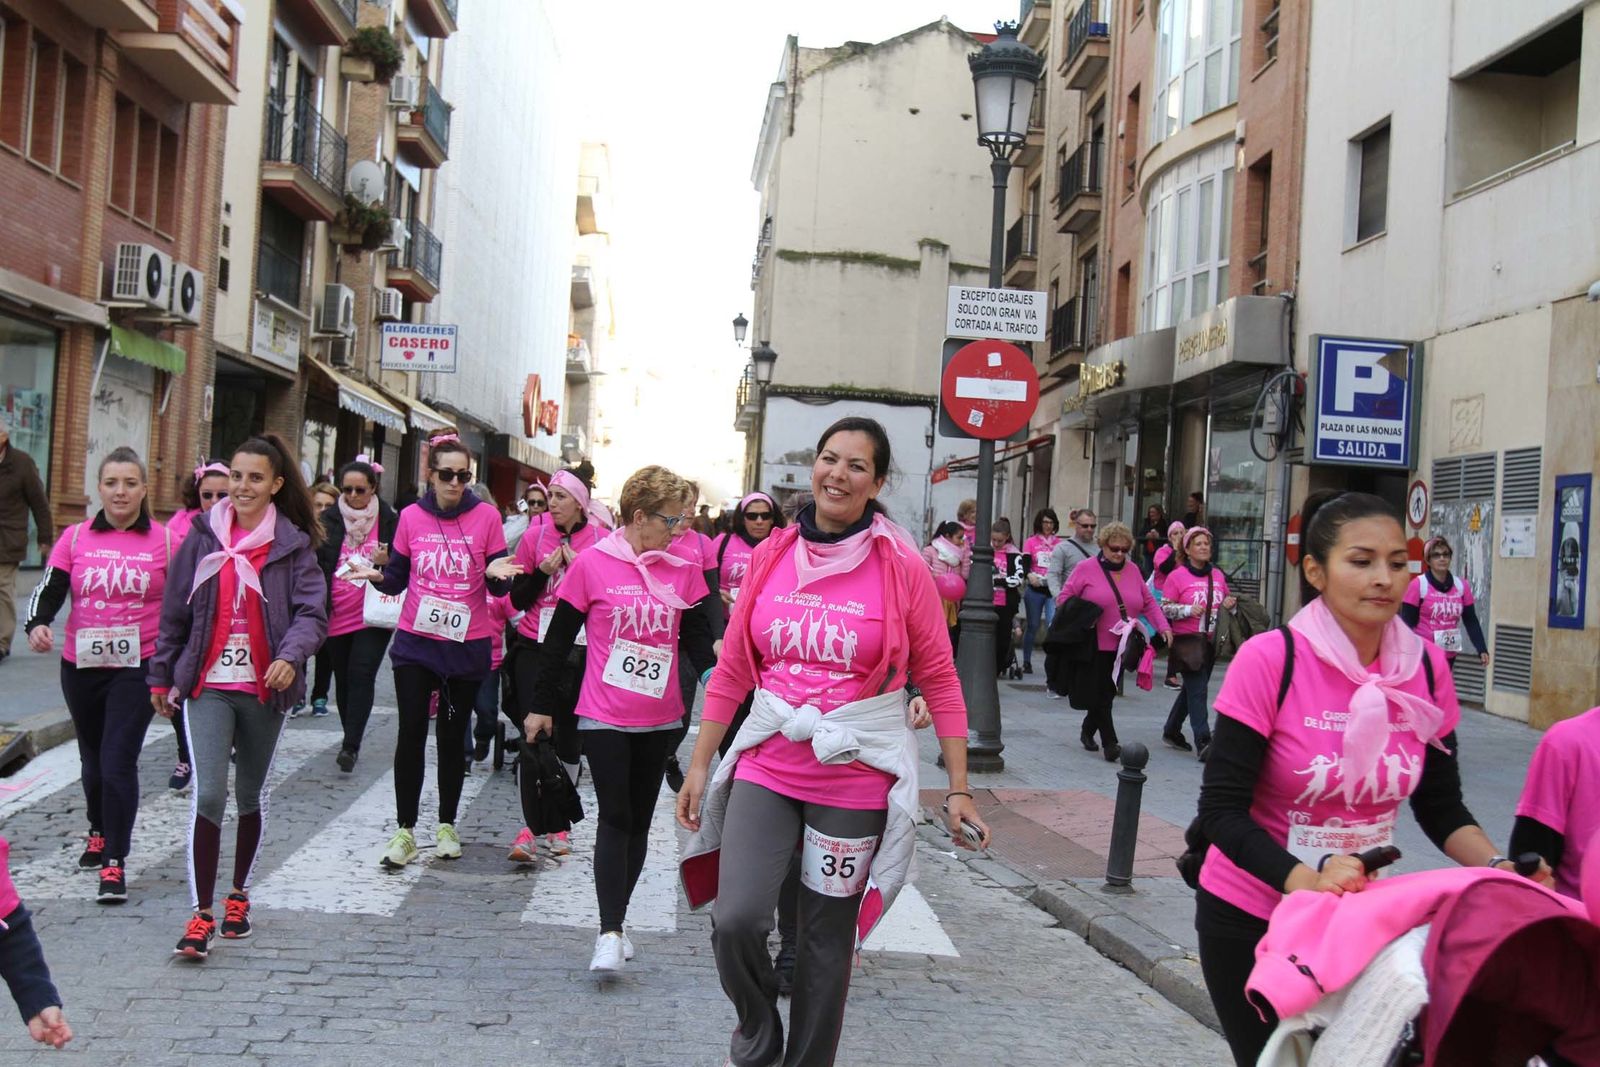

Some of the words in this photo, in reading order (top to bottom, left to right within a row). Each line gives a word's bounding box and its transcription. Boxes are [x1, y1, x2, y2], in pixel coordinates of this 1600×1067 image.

[960, 289, 996, 302] EXCEPTO
[998, 292, 1034, 305] GARAJES
[957, 303, 979, 315] SOLO
[980, 305, 998, 317] CON
[999, 307, 1021, 319] GRAN
[1024, 309, 1037, 320] VIA
[384, 325, 455, 336] ALMACENES
[954, 318, 992, 331] CORTADA
[993, 321, 1003, 332] AL
[1005, 322, 1038, 335] TRAFICO
[388, 336, 450, 350] CASERO
[1334, 349, 1390, 412] P
[1320, 422, 1344, 432] PLAZA
[1345, 424, 1355, 433] DE
[1356, 425, 1370, 434] LAS
[1371, 426, 1402, 436] MONJAS
[1337, 440, 1387, 457] SALIDA
[784, 596, 793, 604] LA
[794, 599, 821, 609] MUJER
[827, 603, 865, 616] RUNNING
[790, 591, 823, 602] CARRERA
[847, 600, 866, 610] PINK
[429, 608, 461, 628] 510
[91, 639, 130, 655] 519
[622, 655, 661, 680] 623
[1304, 716, 1319, 729] DE
[1319, 719, 1331, 731] LA
[819, 843, 840, 853] MUJER
[846, 845, 874, 854] RUNNING
[1296, 837, 1309, 847] DE
[1311, 838, 1323, 847] LA
[821, 854, 856, 879] 35
